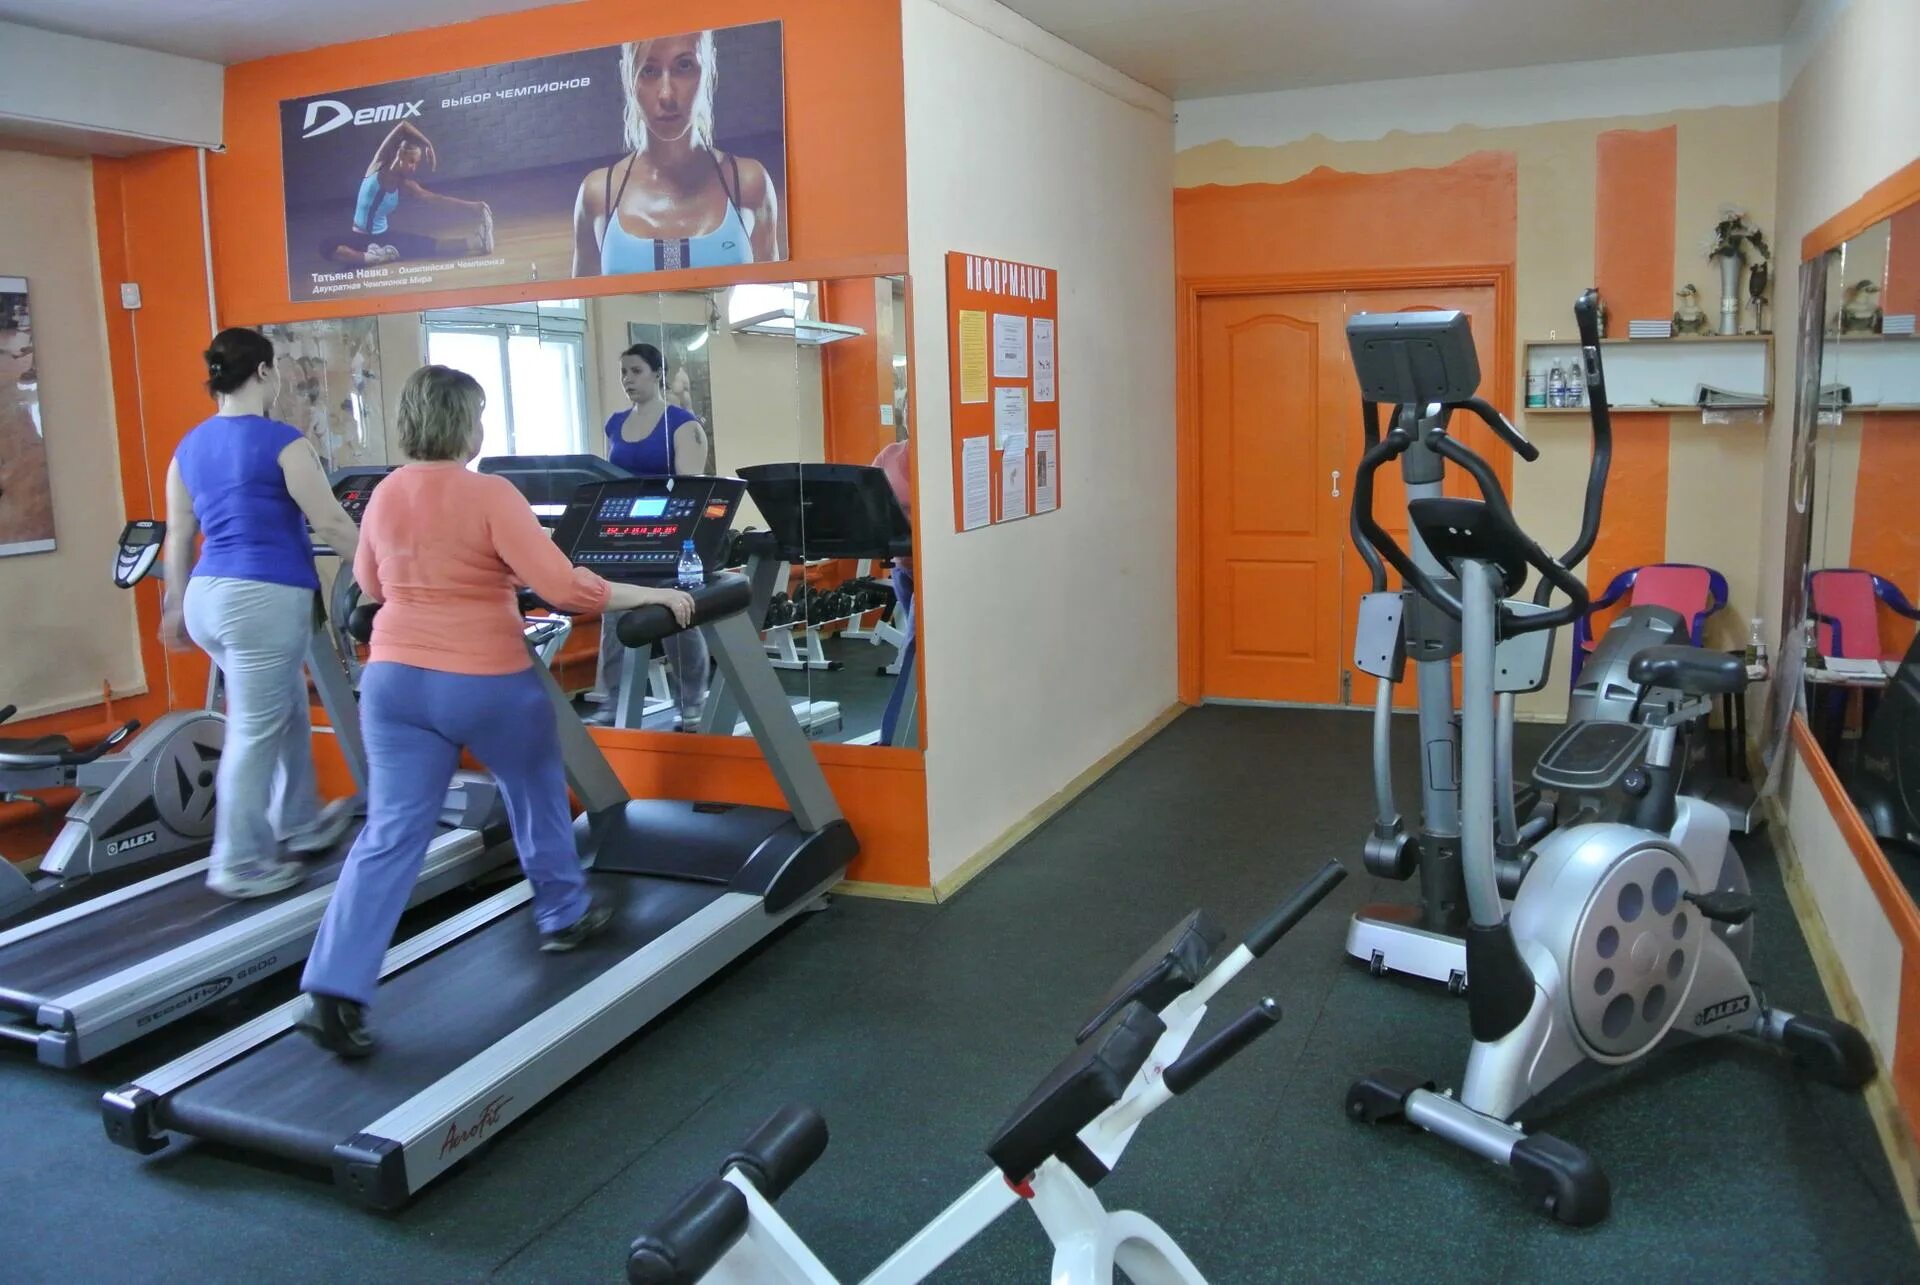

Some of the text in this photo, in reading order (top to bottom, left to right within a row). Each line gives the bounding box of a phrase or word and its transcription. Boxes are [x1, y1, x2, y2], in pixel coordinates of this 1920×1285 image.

[441, 76, 591, 108] ВЫБОР ЧЕМПИОНОВ
[311, 271, 354, 283] Татьяна
[356, 267, 389, 279] Навка
[398, 262, 454, 274] Олимпийская
[457, 257, 505, 268] Чемпионка
[966, 255, 1047, 303] ИНФОРМАЦИЯ
[312, 274, 432, 295] Двукратная Чемпионка Мира
[119, 831, 155, 852] ALEX
[1705, 997, 1748, 1023] ALEX
